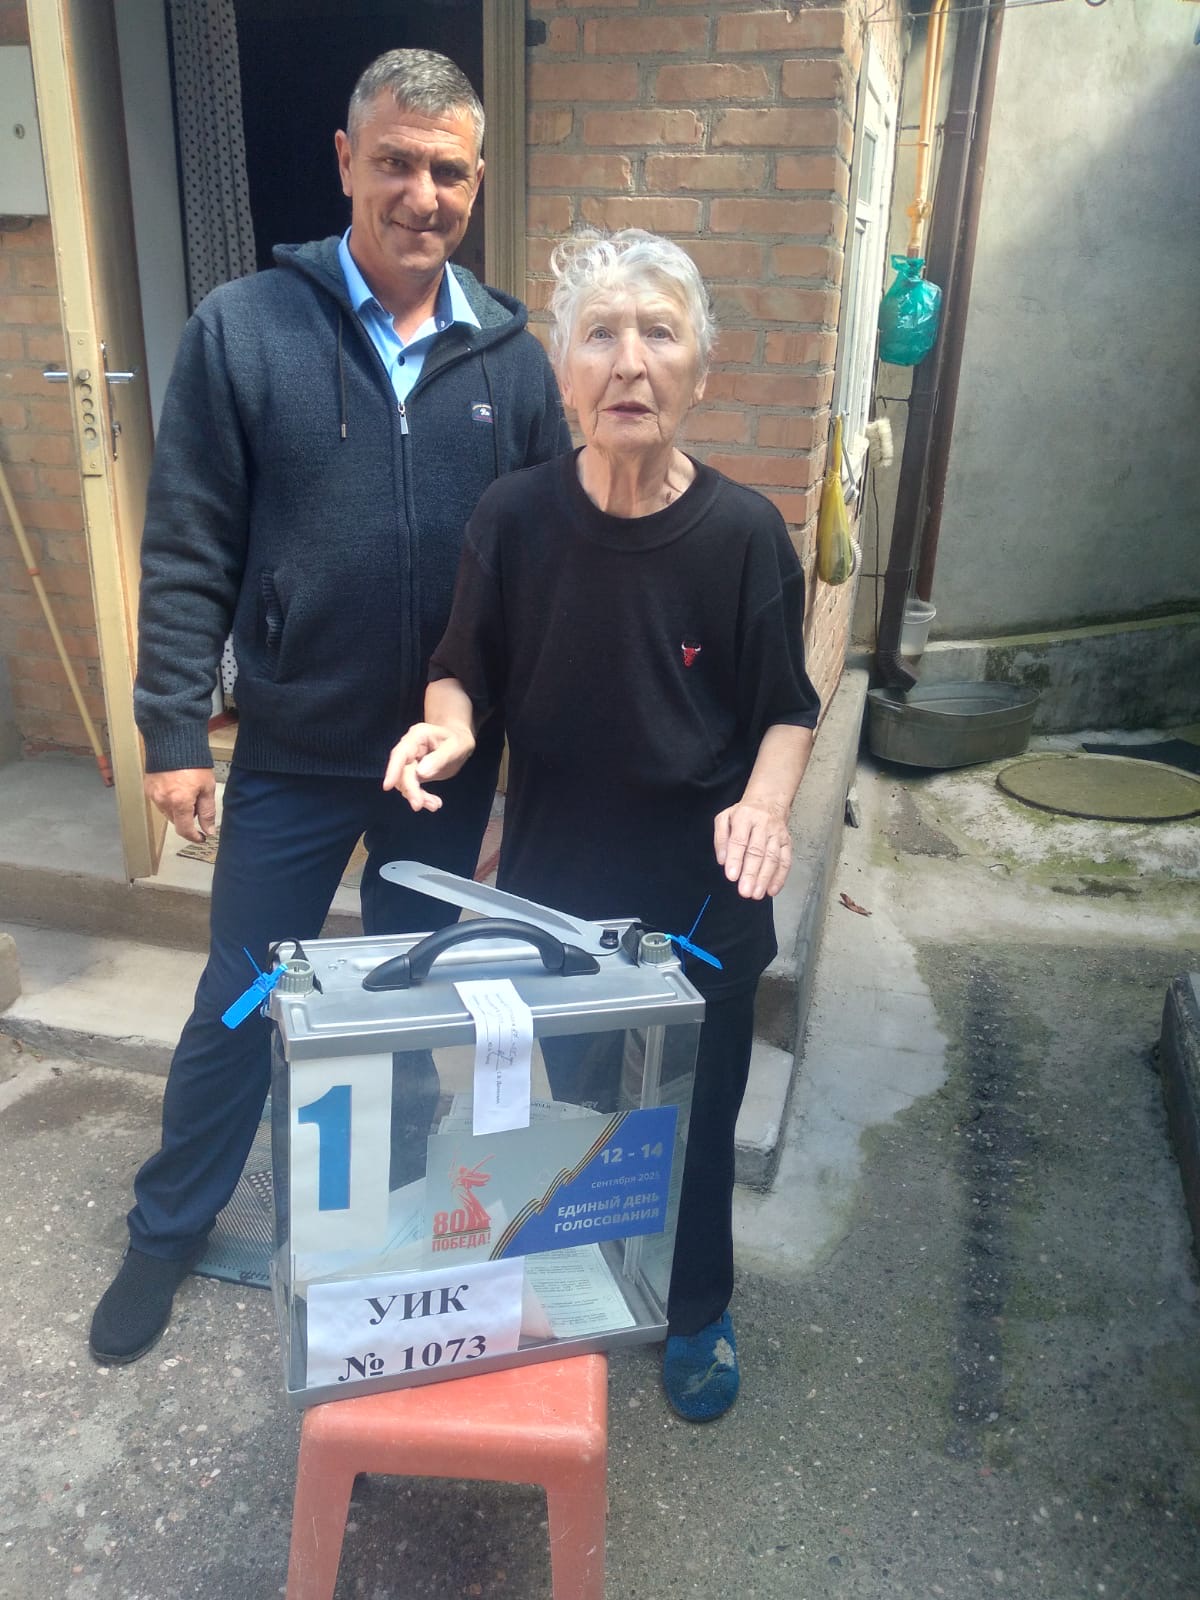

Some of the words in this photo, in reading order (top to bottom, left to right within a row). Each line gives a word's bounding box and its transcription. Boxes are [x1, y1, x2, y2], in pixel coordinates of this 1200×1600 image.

[298, 1085, 352, 1211] 1
[601, 1147, 623, 1164] 12
[641, 1141, 663, 1158] 14
[591, 1174, 636, 1189] сентября
[557, 1194, 620, 1218] ЕДИНЫЙ
[623, 1192, 659, 1209] ДЕНЬ
[433, 1208, 466, 1235] 80
[554, 1207, 659, 1232] ГОЛОСОВАНИЯ
[432, 1231, 491, 1252] ПОБЕДА!
[364, 1284, 469, 1325] УИК
[338, 1352, 385, 1382] №
[401, 1335, 486, 1370] 1073
